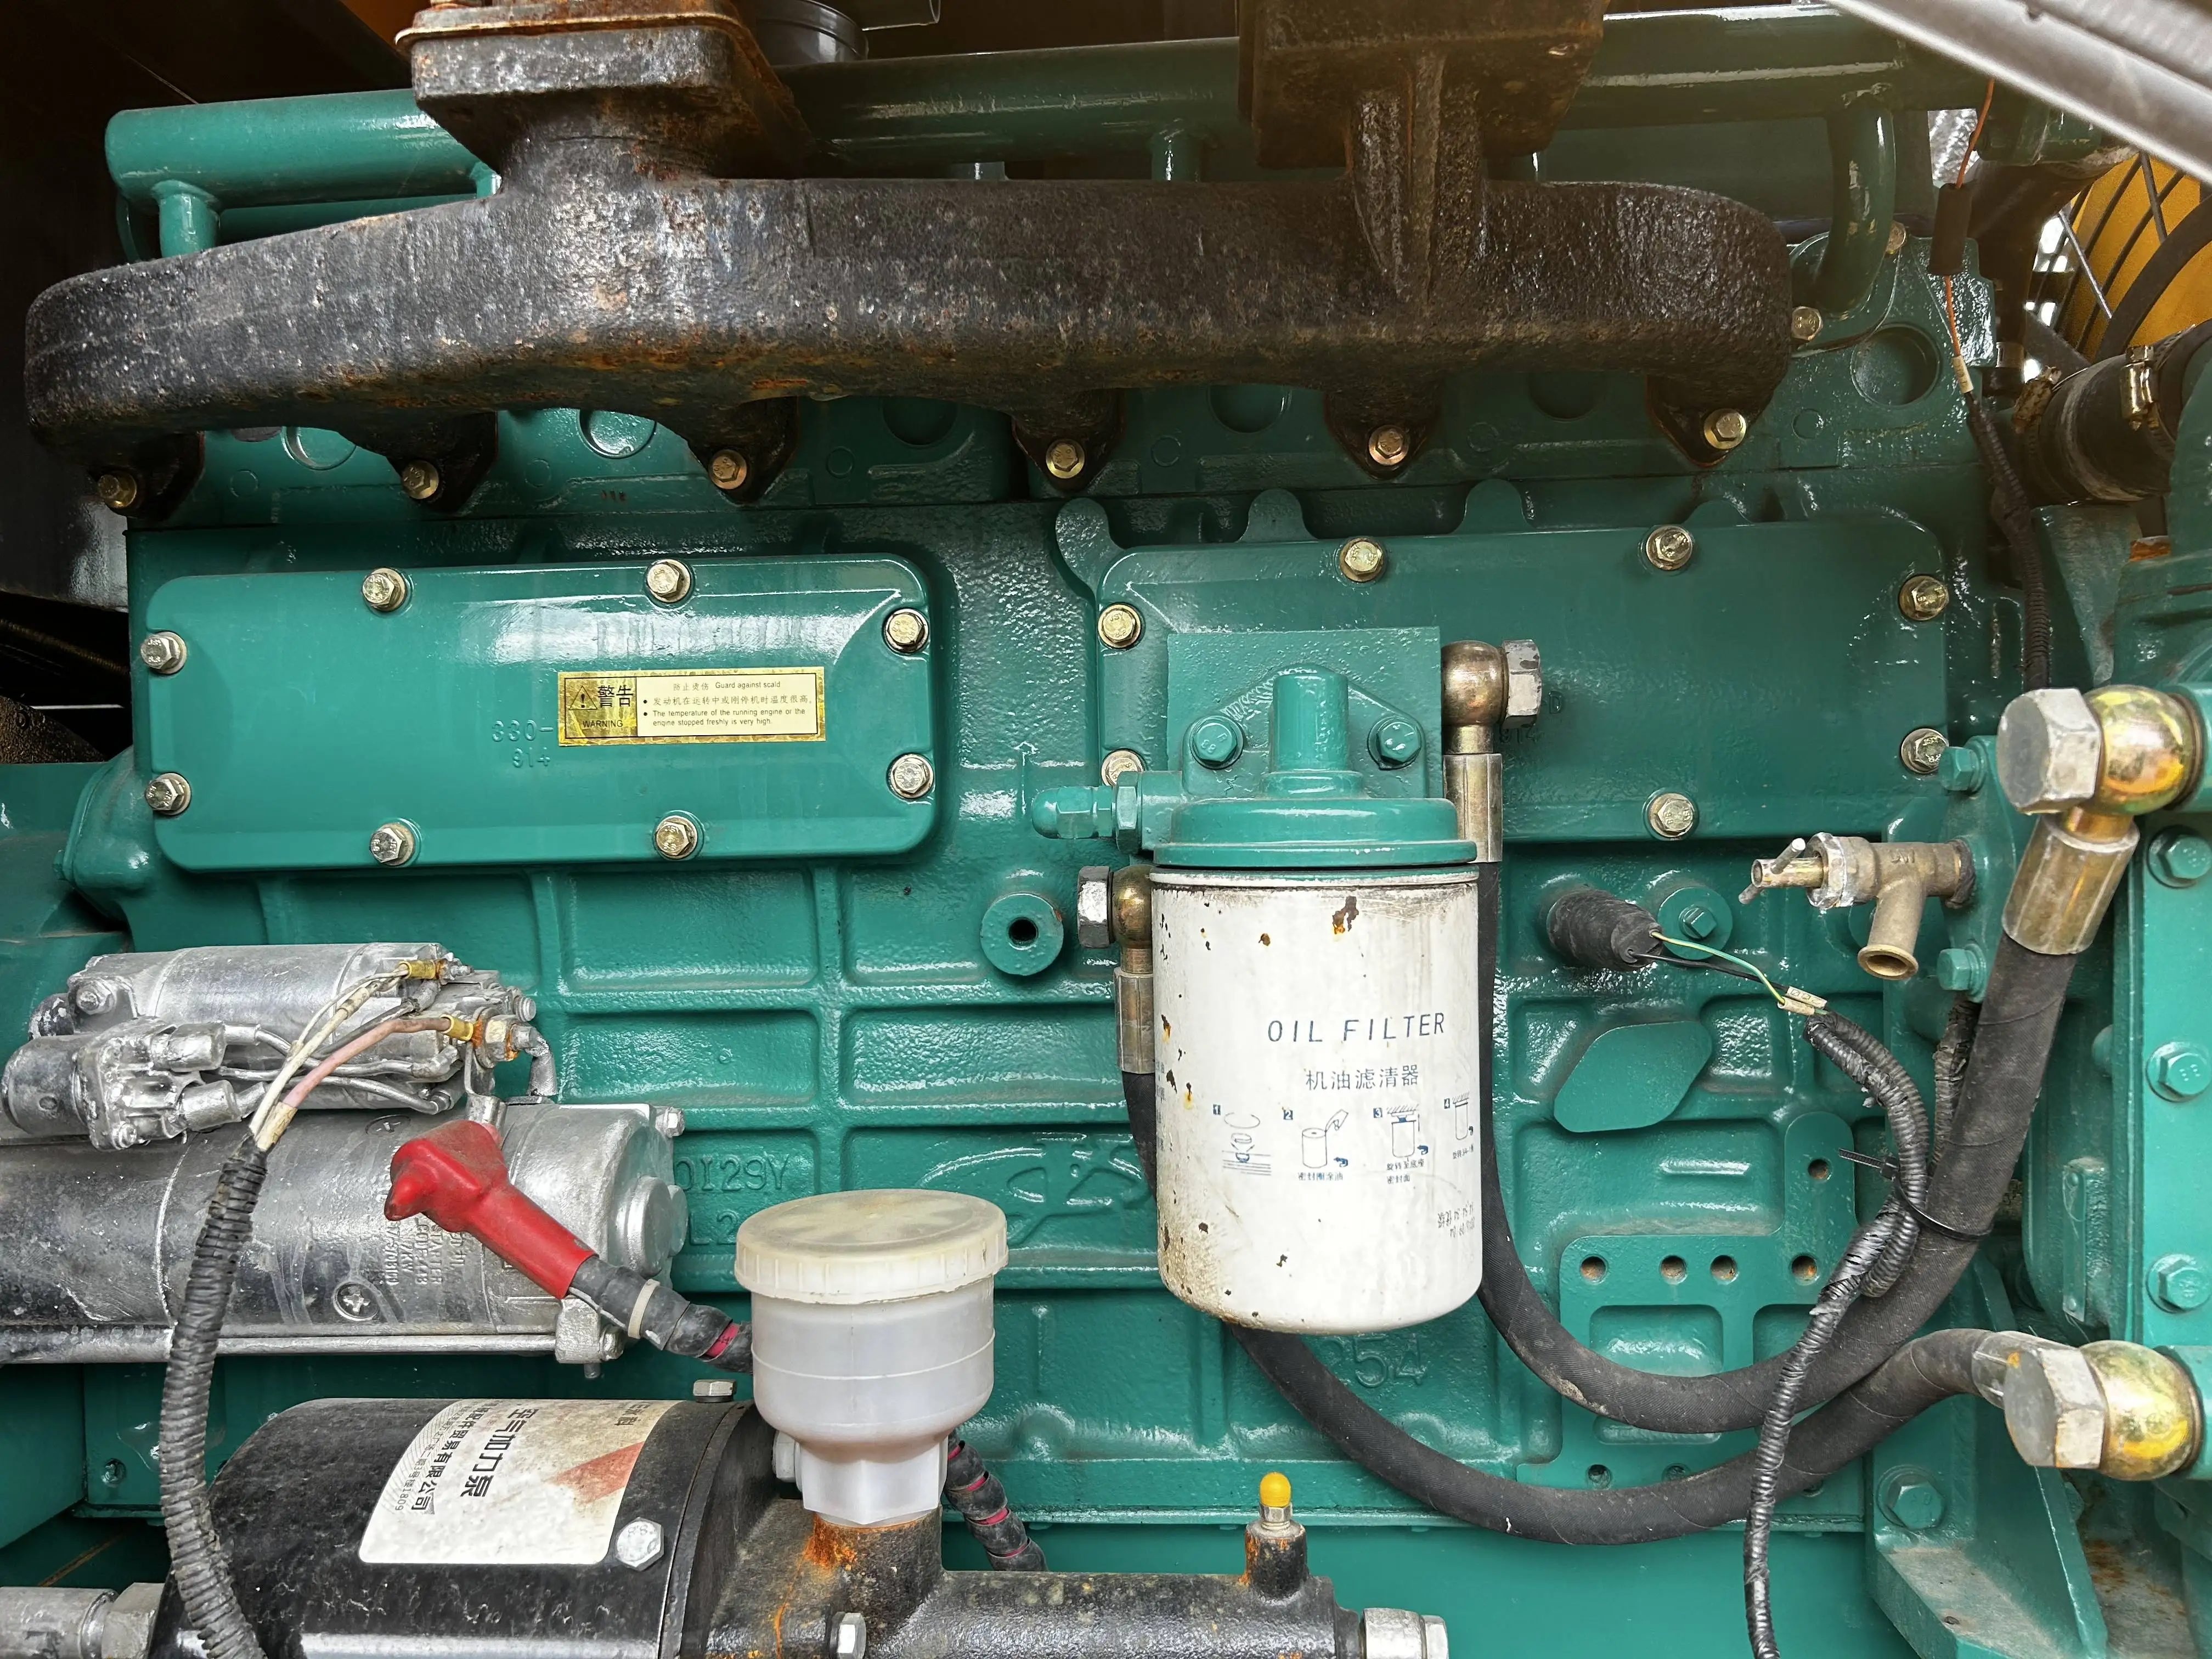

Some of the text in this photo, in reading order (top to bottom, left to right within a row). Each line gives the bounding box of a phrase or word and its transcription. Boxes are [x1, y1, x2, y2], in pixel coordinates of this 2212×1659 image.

[597, 685, 634, 707] 警告
[673, 682, 709, 691] 防止烫伤
[678, 719, 704, 727] stopped
[1267, 1012, 1445, 1043] OIL FILTER
[1305, 1064, 1420, 1091] 机油滤清器
[460, 1408, 539, 1498] 空气加力泵
